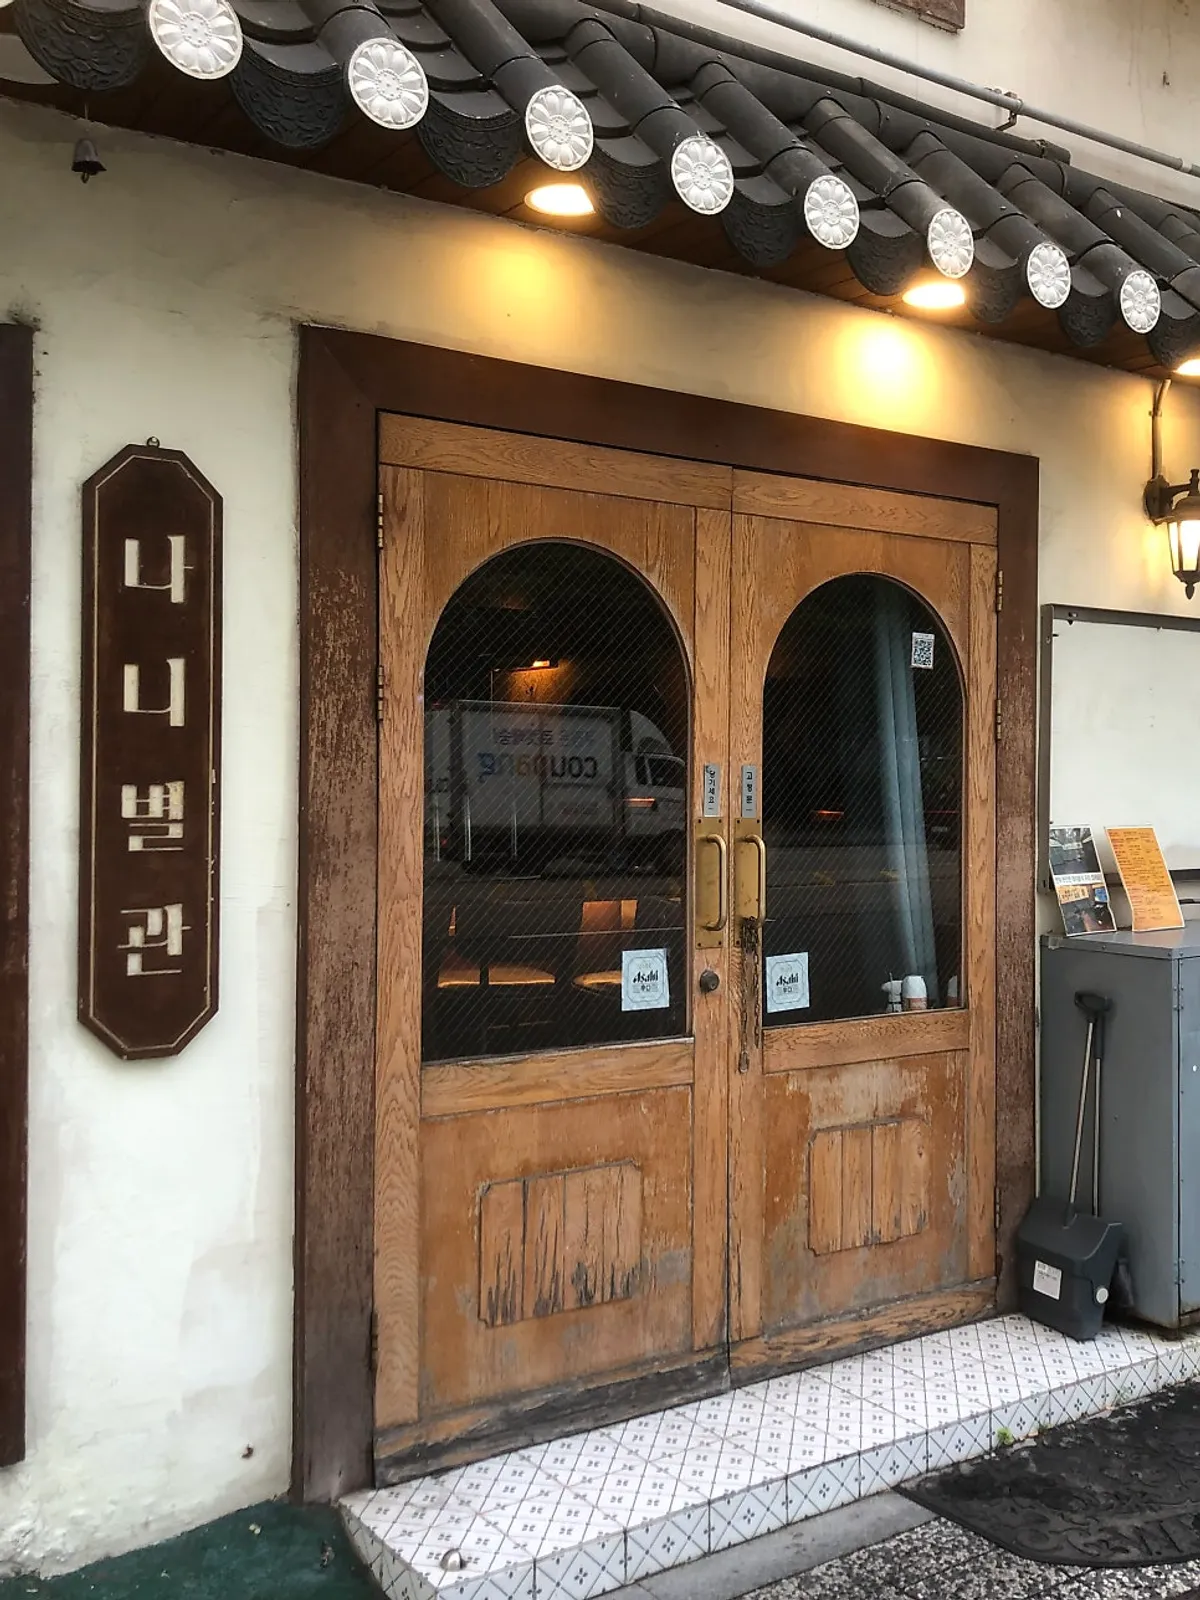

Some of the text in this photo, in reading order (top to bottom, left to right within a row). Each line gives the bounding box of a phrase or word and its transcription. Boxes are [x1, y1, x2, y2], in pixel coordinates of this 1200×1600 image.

[117, 534, 194, 977] 나니별관
[632, 969, 659, 983] Asahi
[776, 972, 799, 987] Asahi
